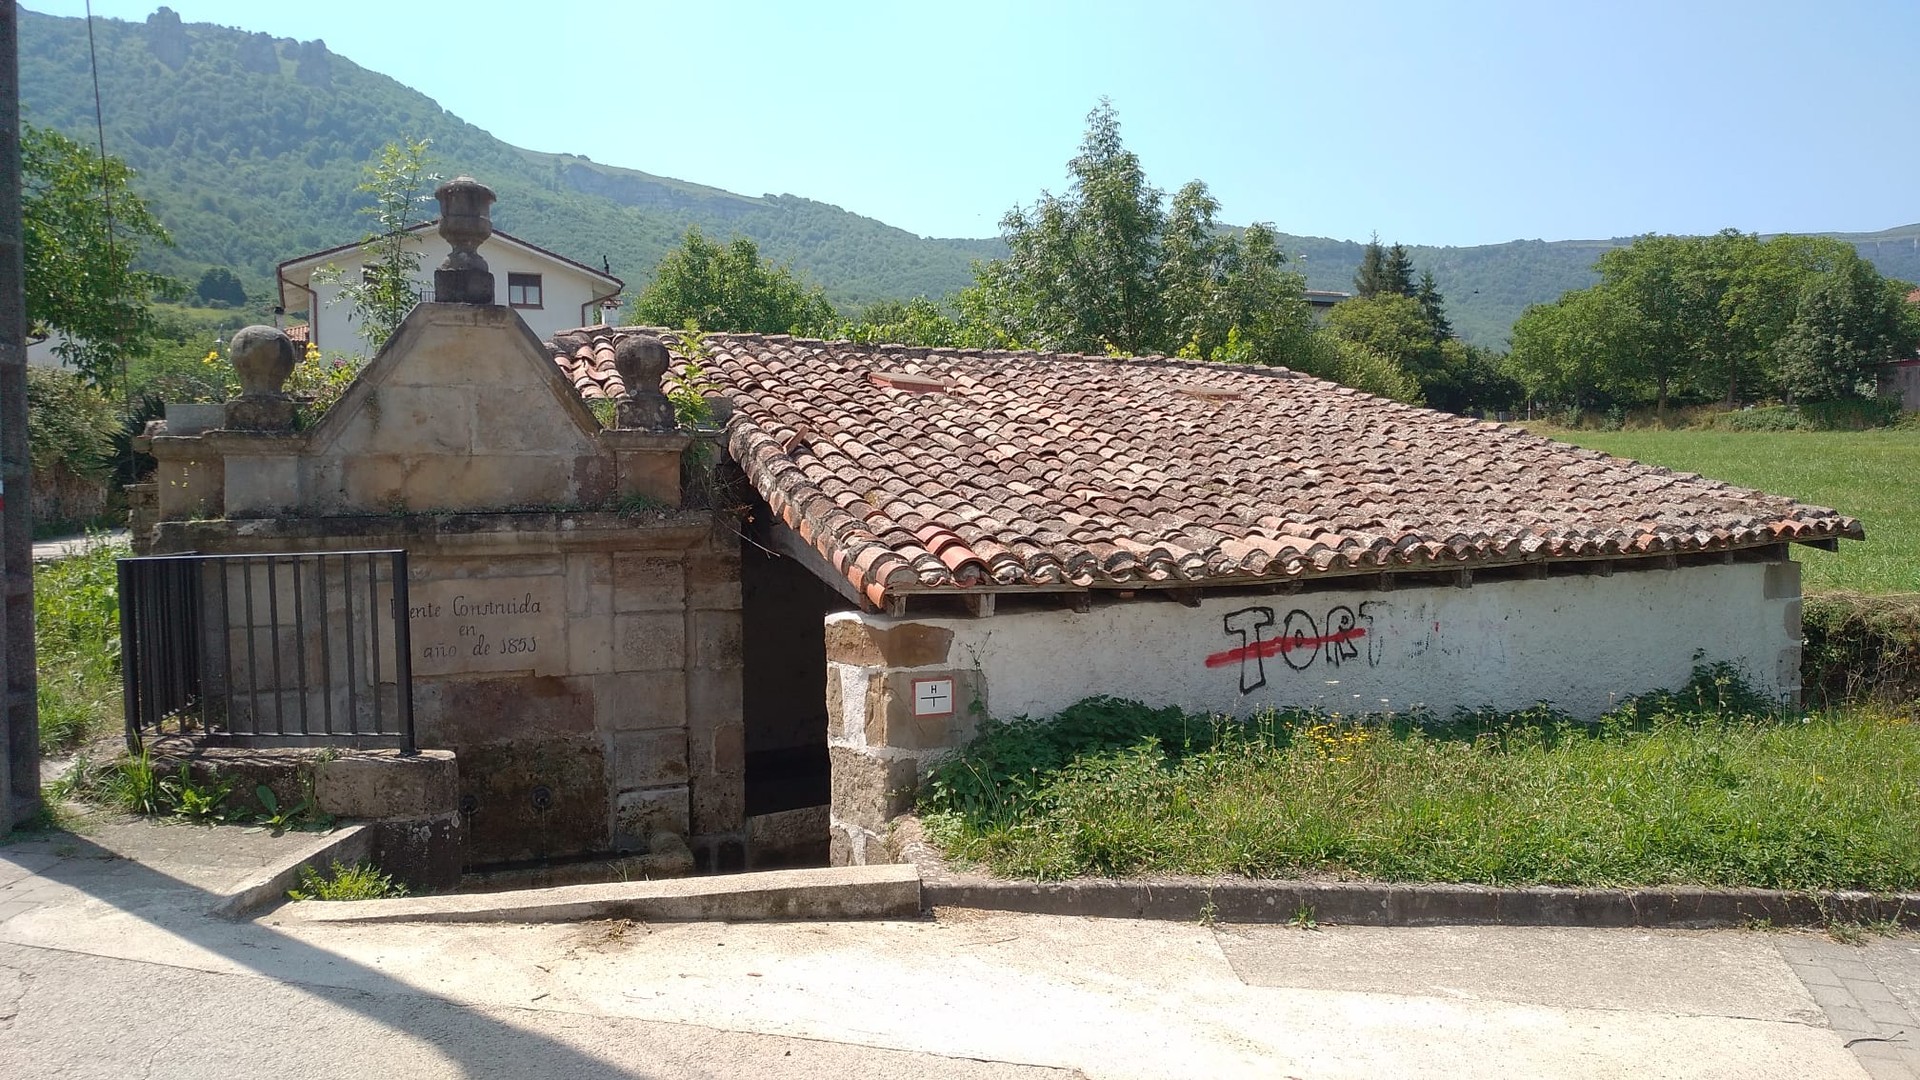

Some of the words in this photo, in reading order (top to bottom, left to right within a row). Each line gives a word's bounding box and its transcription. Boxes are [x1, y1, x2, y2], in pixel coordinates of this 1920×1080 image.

[453, 593, 541, 616] Construida
[459, 624, 476, 636] en
[424, 642, 457, 659] año
[472, 634, 491, 656] de
[930, 684, 937, 694] H
